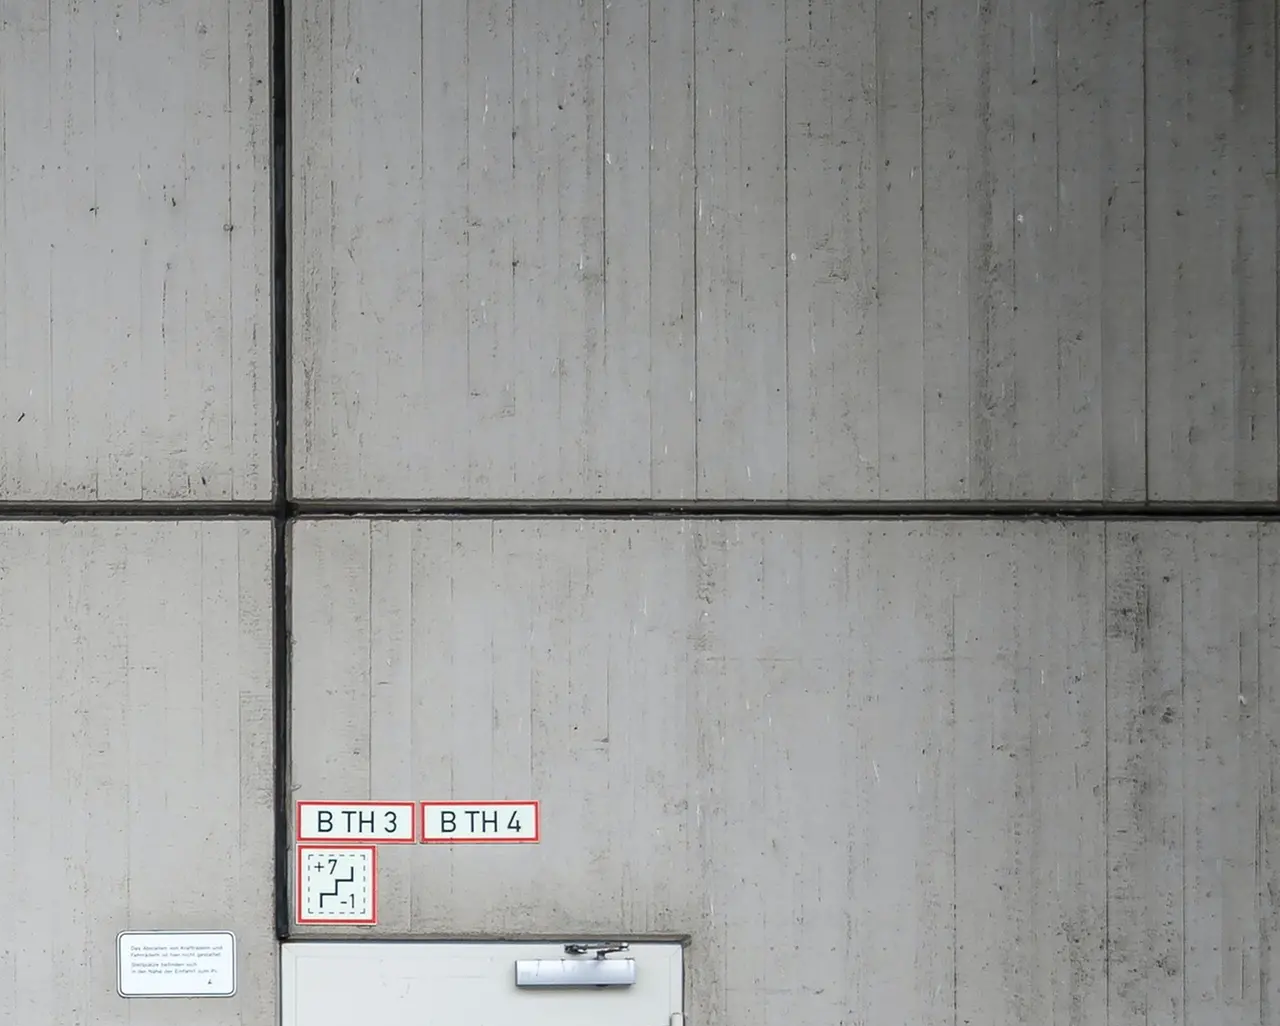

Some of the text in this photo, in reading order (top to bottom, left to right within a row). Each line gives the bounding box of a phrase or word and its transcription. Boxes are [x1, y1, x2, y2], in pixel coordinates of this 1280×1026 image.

[317, 810, 397, 833] B TH 3
[440, 810, 522, 833] B TH 4
[313, 858, 338, 875] +7
[339, 893, 356, 909] -1
